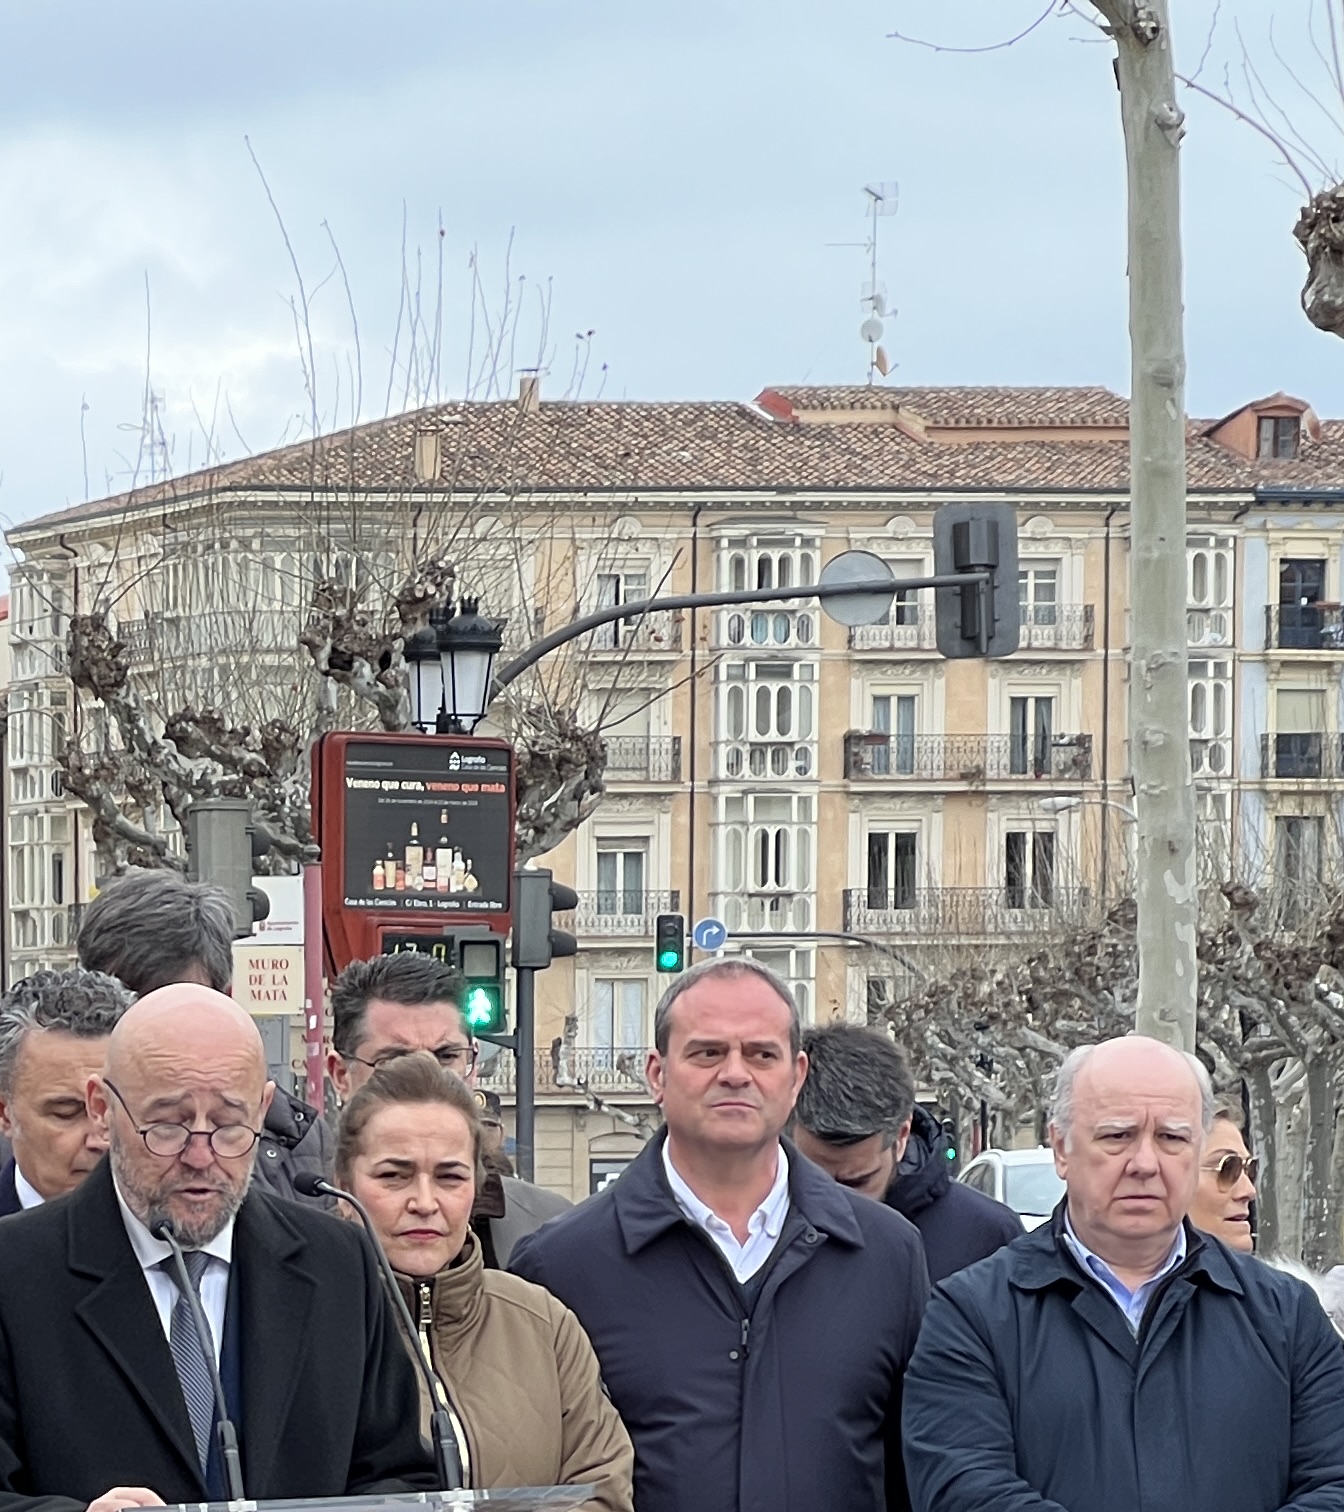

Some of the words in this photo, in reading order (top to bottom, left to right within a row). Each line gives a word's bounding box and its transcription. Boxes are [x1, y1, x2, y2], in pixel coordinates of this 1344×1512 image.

[248, 958, 290, 971] MURO
[249, 974, 266, 986] DE
[272, 974, 289, 986] LA
[250, 989, 288, 1001] MATA
